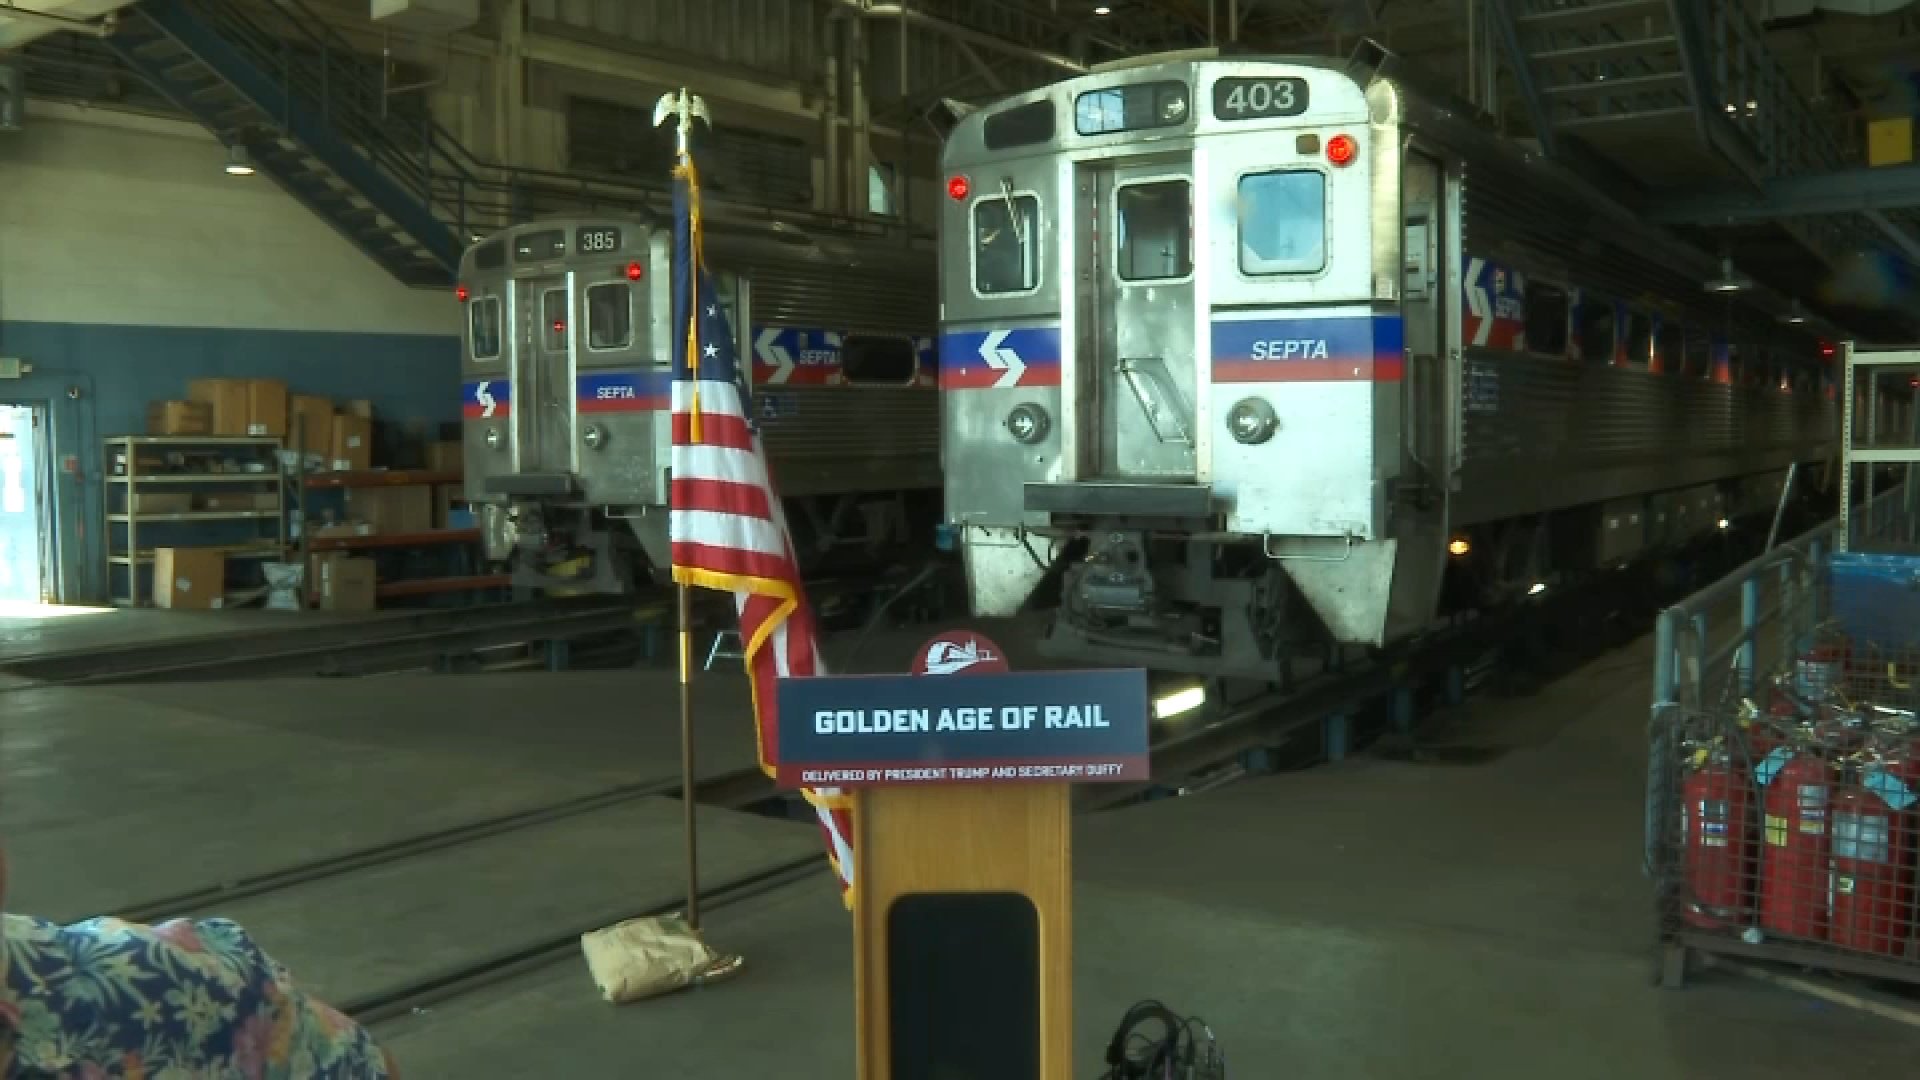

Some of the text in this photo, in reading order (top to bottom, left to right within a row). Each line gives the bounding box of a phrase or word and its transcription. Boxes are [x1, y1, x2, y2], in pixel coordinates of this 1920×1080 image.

[1225, 81, 1296, 114] 403
[582, 232, 615, 251] 385
[1250, 338, 1329, 362] SEPTA
[596, 386, 636, 400] SEPTA
[814, 703, 1111, 735] GOLDEN AGE OF RAIL
[801, 762, 1124, 783] DELIVERED BY PRESIDENT TRUMP AND SECRETARY DUFFY
